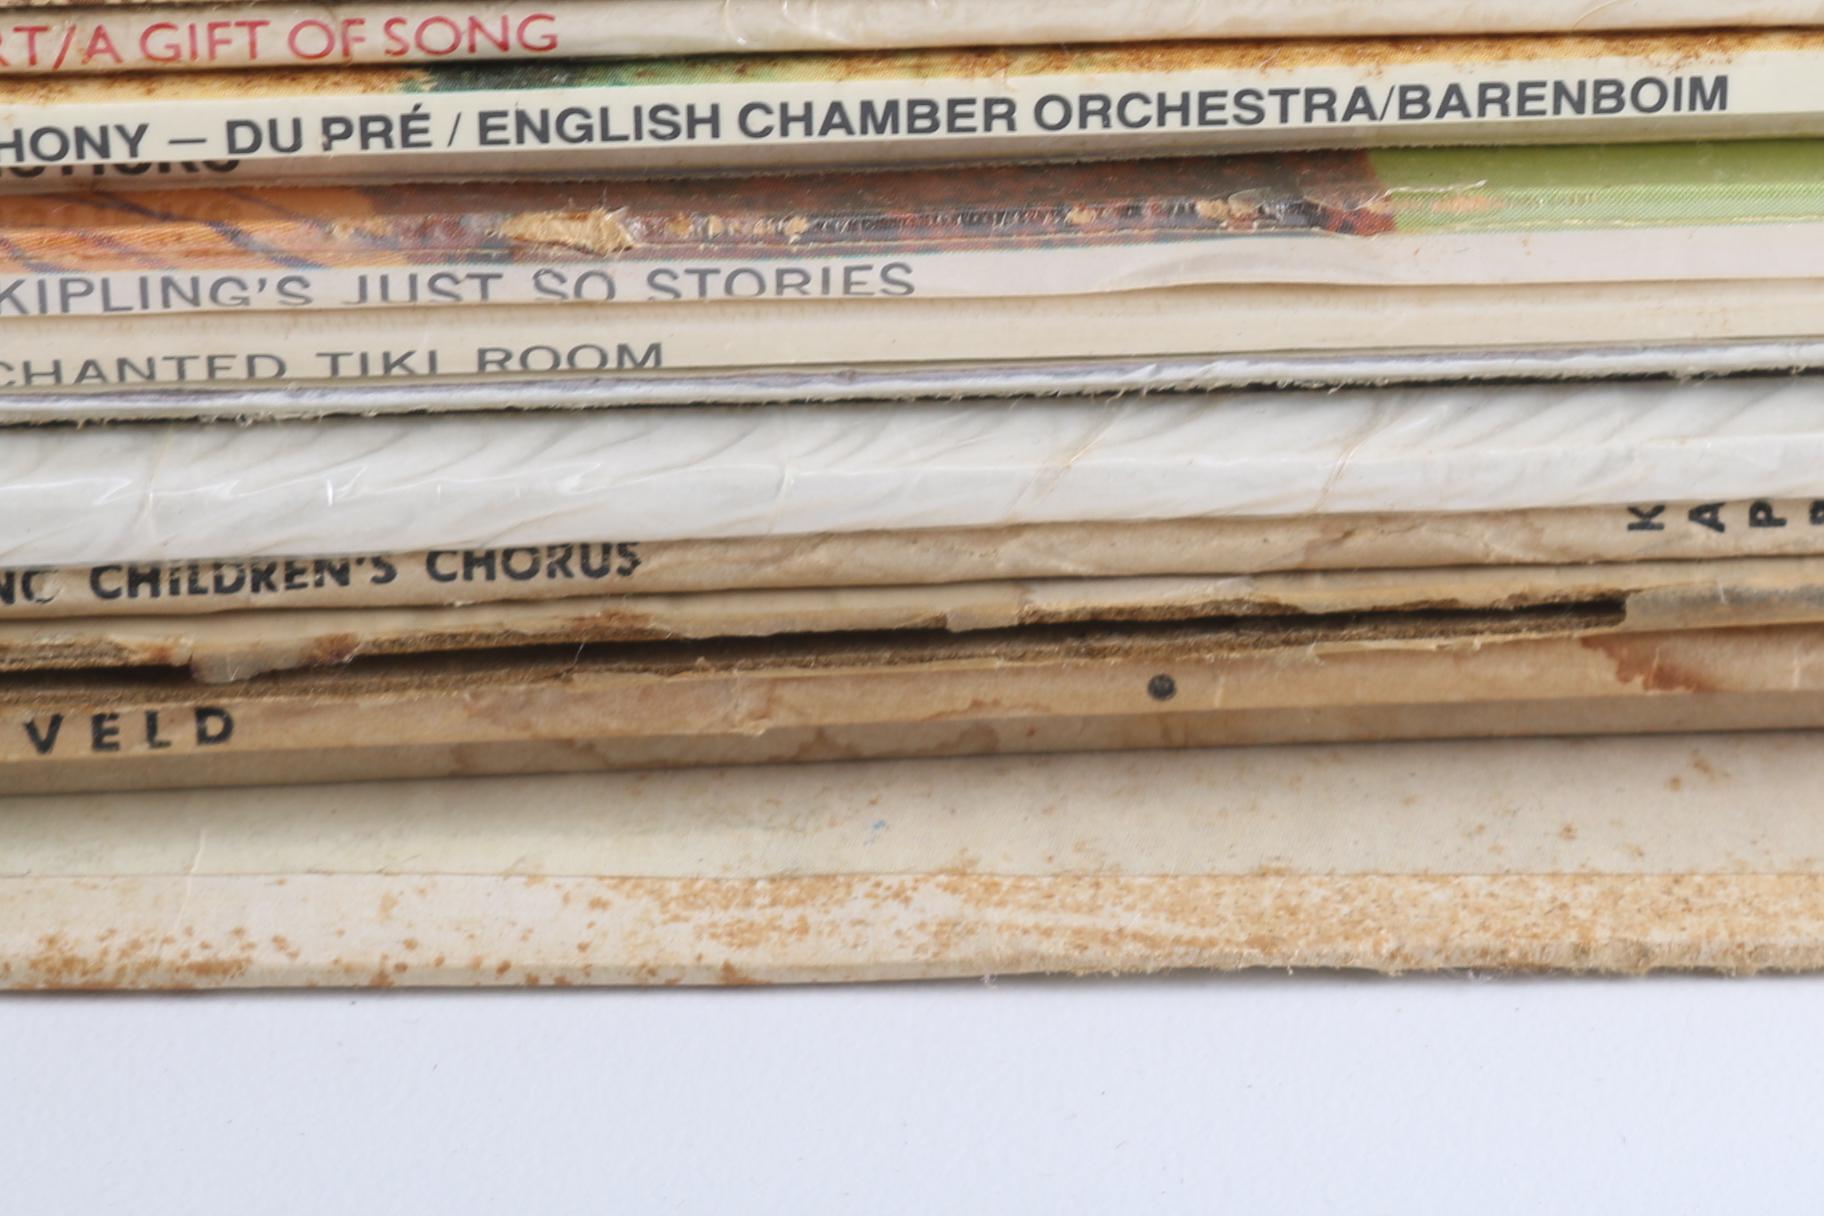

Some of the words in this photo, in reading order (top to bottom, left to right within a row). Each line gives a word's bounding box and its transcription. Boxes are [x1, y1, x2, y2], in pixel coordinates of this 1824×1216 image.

[0, 24, 123, 71] T/A
[138, 19, 272, 62] GIFT
[287, 17, 366, 60] OF
[383, 13, 558, 57] SONG
[225, 118, 303, 156] DU
[320, 103, 432, 152] PRÉ
[478, 102, 720, 147] ENGLISH
[737, 96, 1018, 141] CHAMBER
[1033, 74, 1730, 131] ORCHESTRA/BARENBOIM
[339, 270, 504, 305] JUST
[532, 268, 618, 301] SO
[645, 261, 916, 301] STORIES
[315, 349, 438, 380] TIKI
[476, 341, 663, 373] ROOM
[89, 554, 398, 600] CHILDREN'S
[425, 541, 642, 583] CHORUS
[24, 705, 235, 755] VELD
